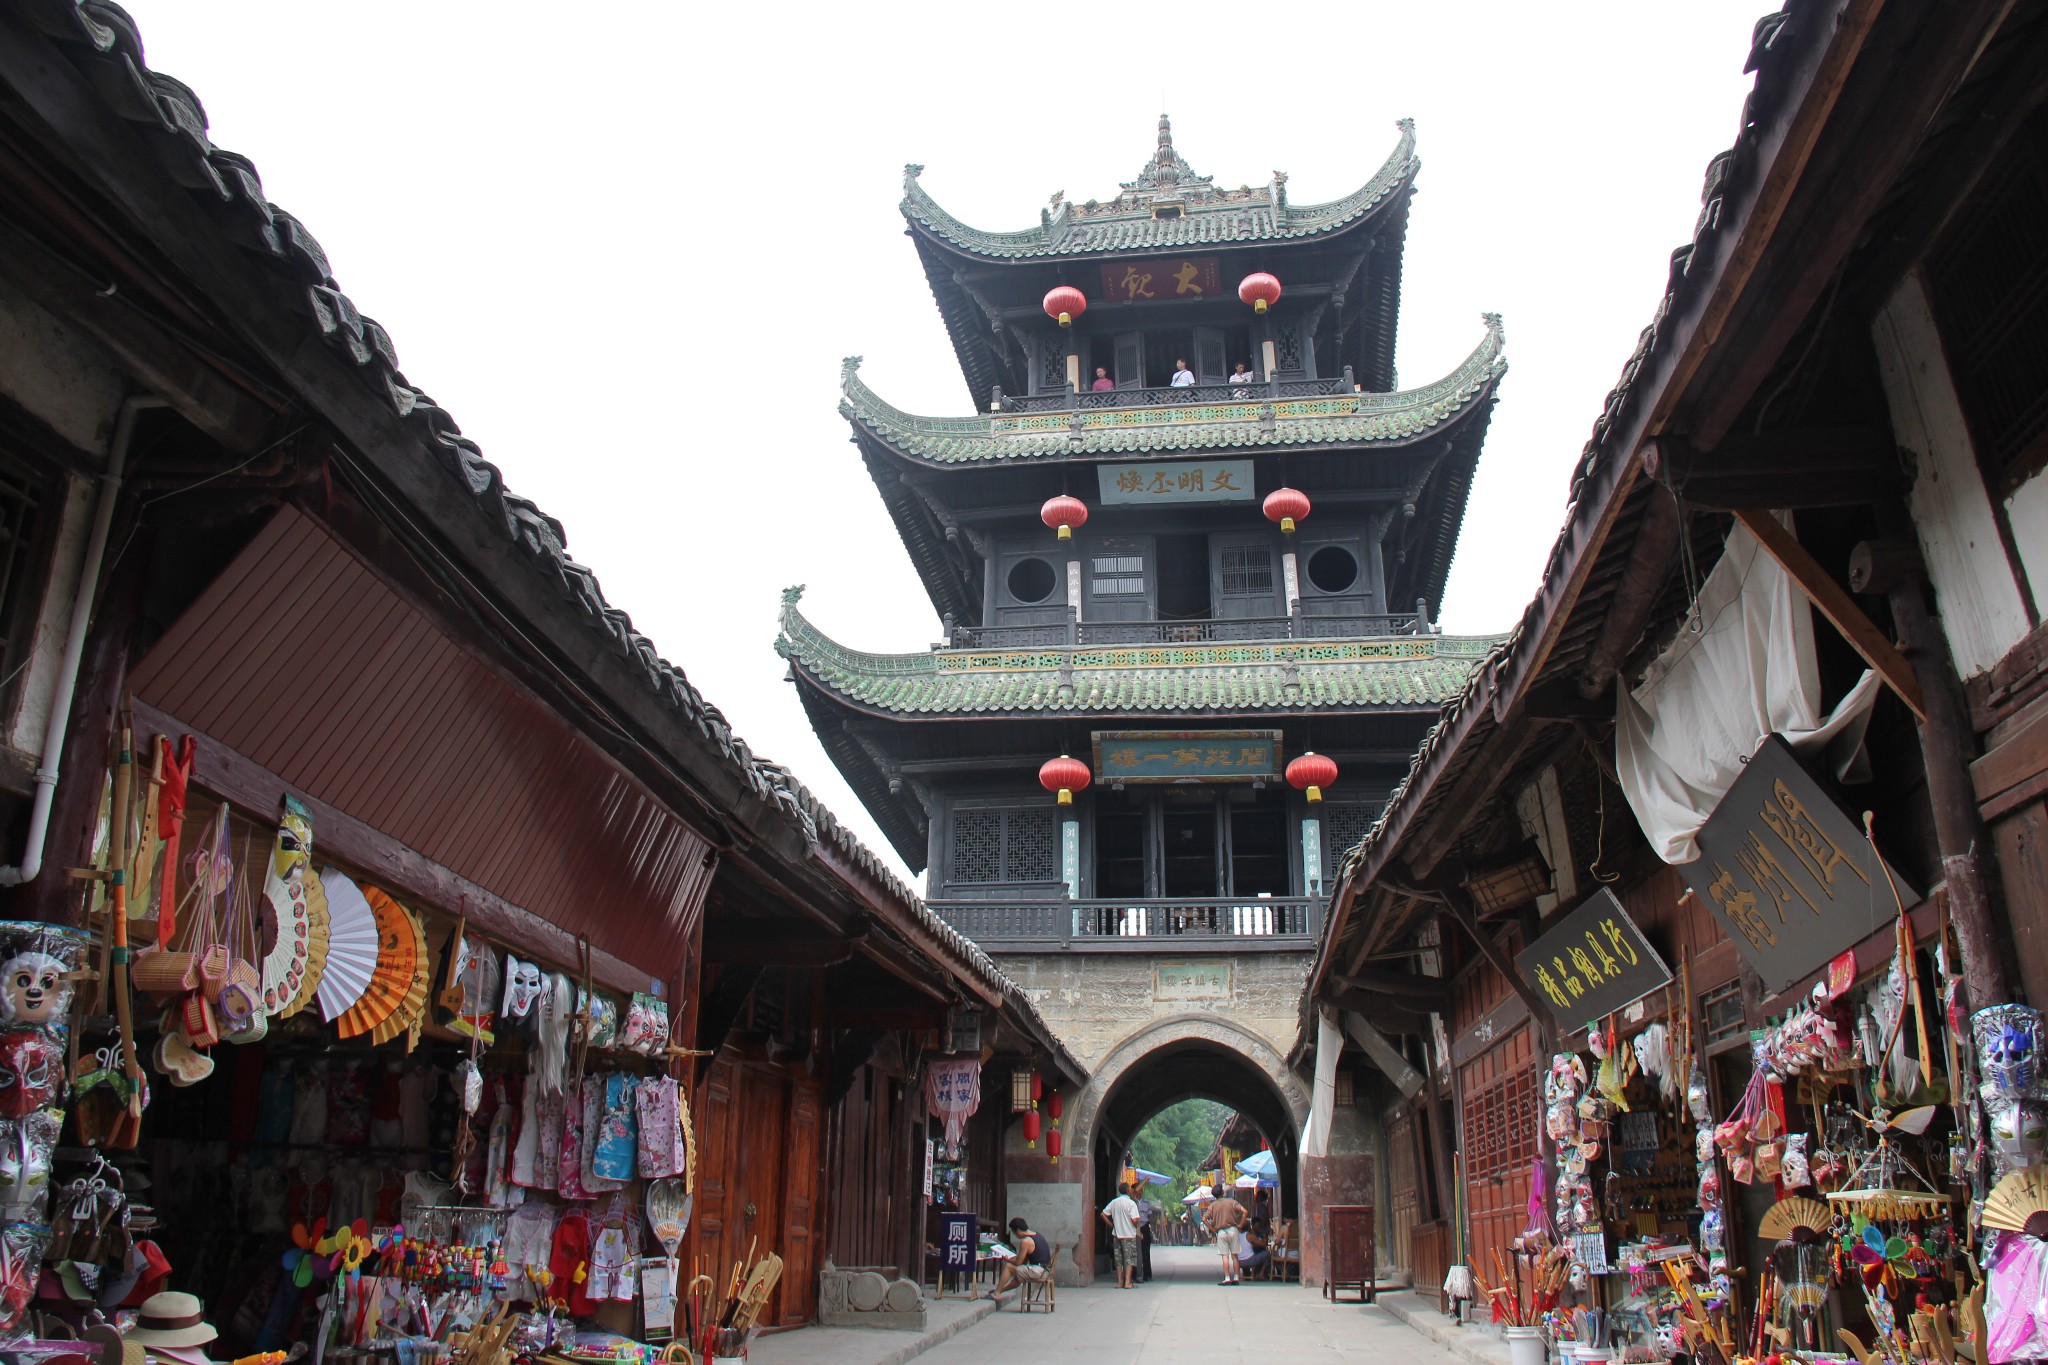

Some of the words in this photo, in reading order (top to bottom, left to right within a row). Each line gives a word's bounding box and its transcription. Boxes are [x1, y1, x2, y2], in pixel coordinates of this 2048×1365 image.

[1534, 918, 1637, 1008] 精品烟具行
[948, 1221, 968, 1266] 厕所
